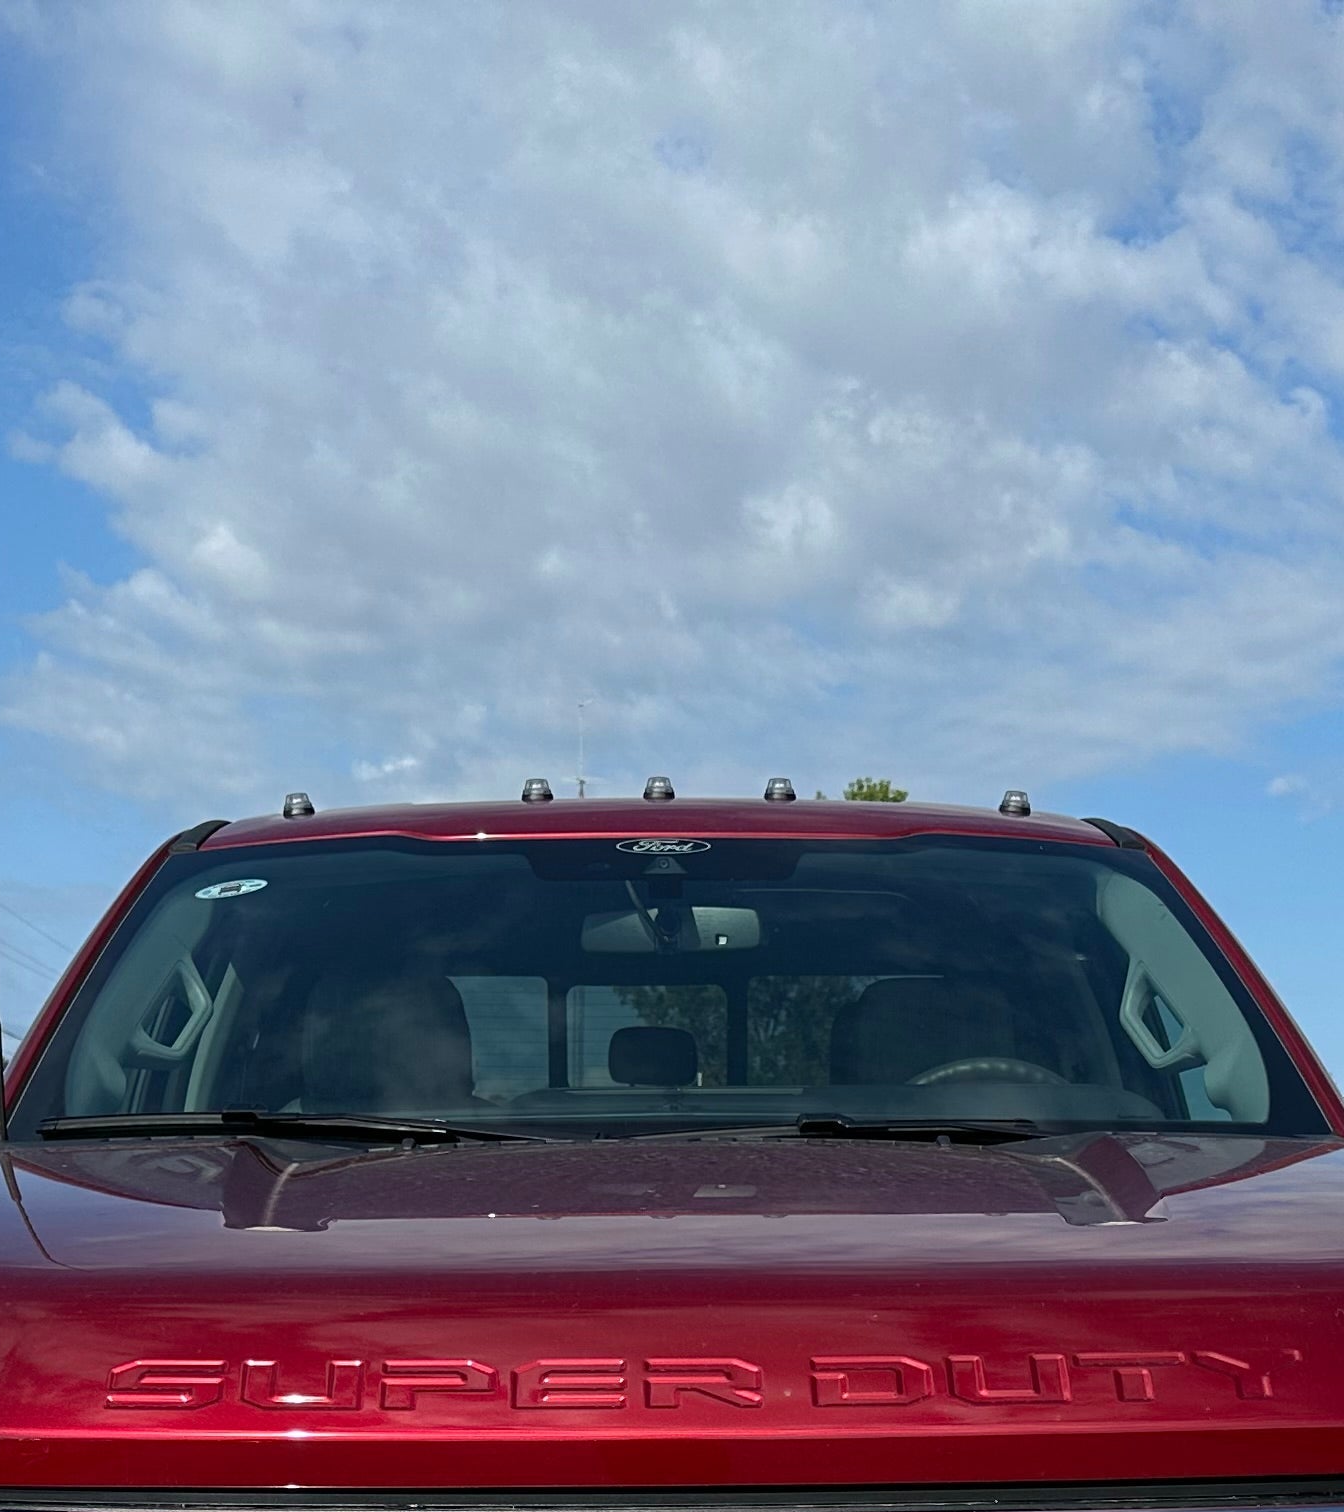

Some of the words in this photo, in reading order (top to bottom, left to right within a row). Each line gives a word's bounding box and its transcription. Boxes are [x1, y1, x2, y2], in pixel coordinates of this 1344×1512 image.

[633, 840, 694, 851] Ford
[104, 1358, 764, 1409] SUPER
[809, 1349, 1302, 1406] DUTY
